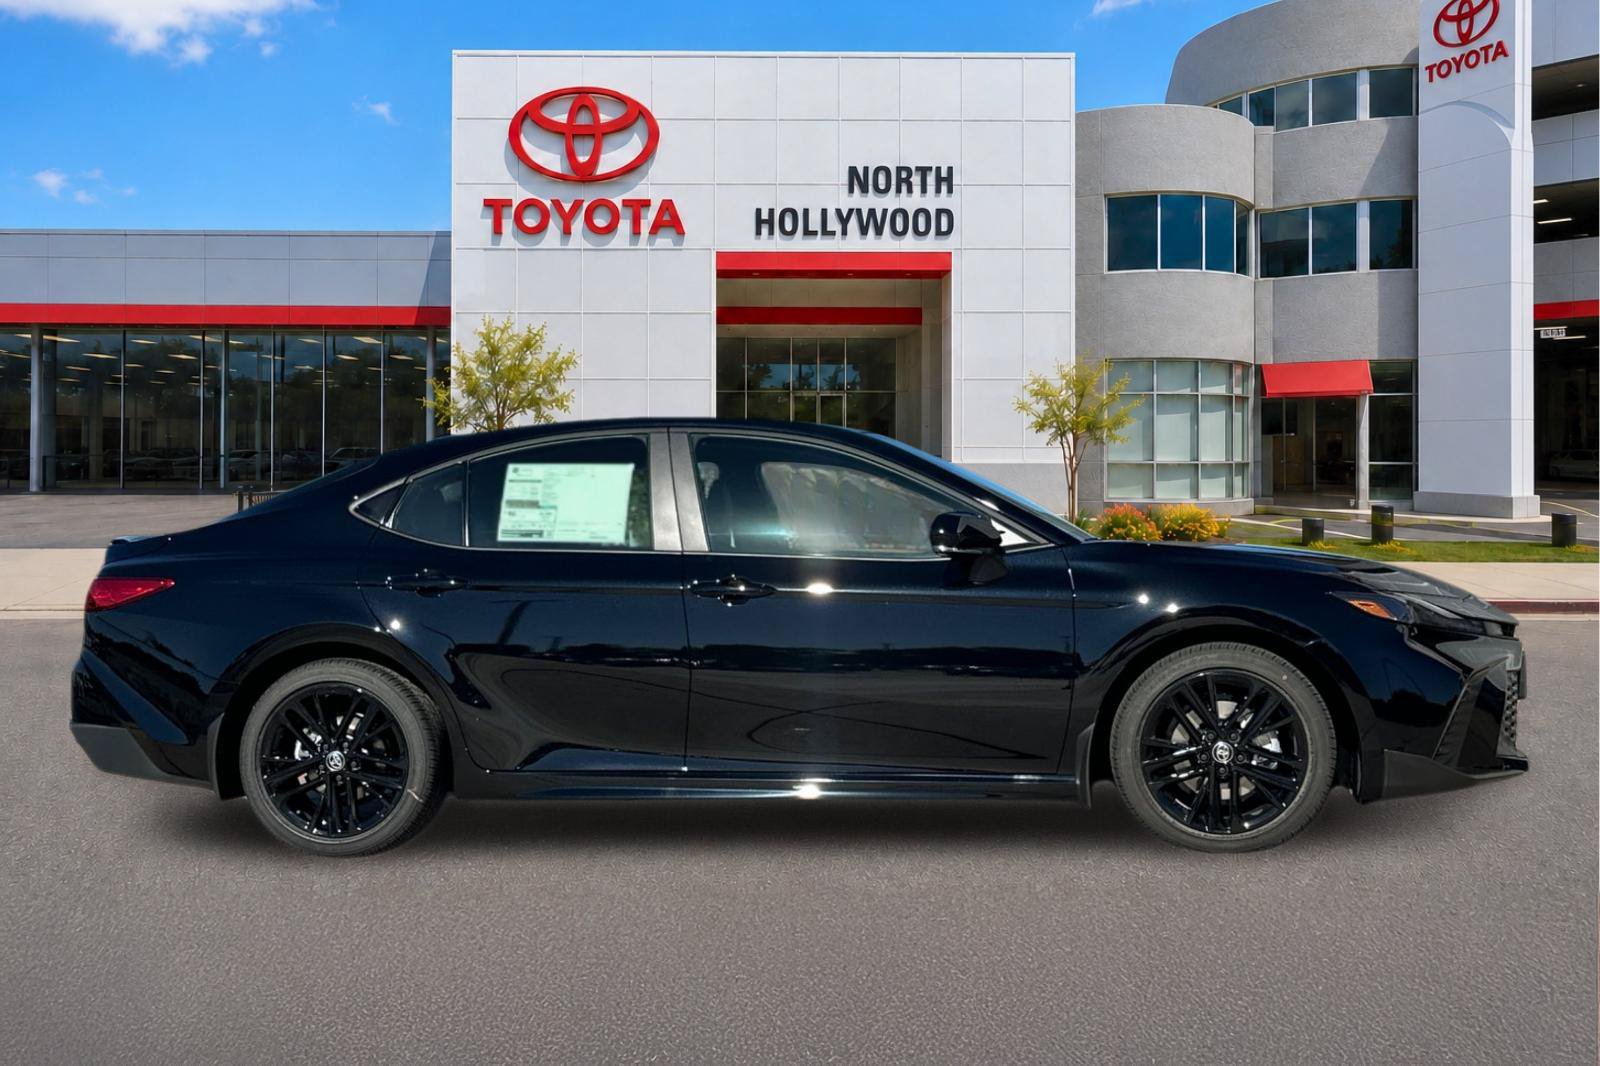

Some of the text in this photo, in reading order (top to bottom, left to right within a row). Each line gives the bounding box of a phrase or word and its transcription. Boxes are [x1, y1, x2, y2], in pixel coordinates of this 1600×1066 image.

[1425, 40, 1509, 83] TOYOTA
[847, 165, 955, 195] NORTH
[483, 198, 686, 236] TOYOTA
[754, 207, 955, 238] HOLLYWOOD
